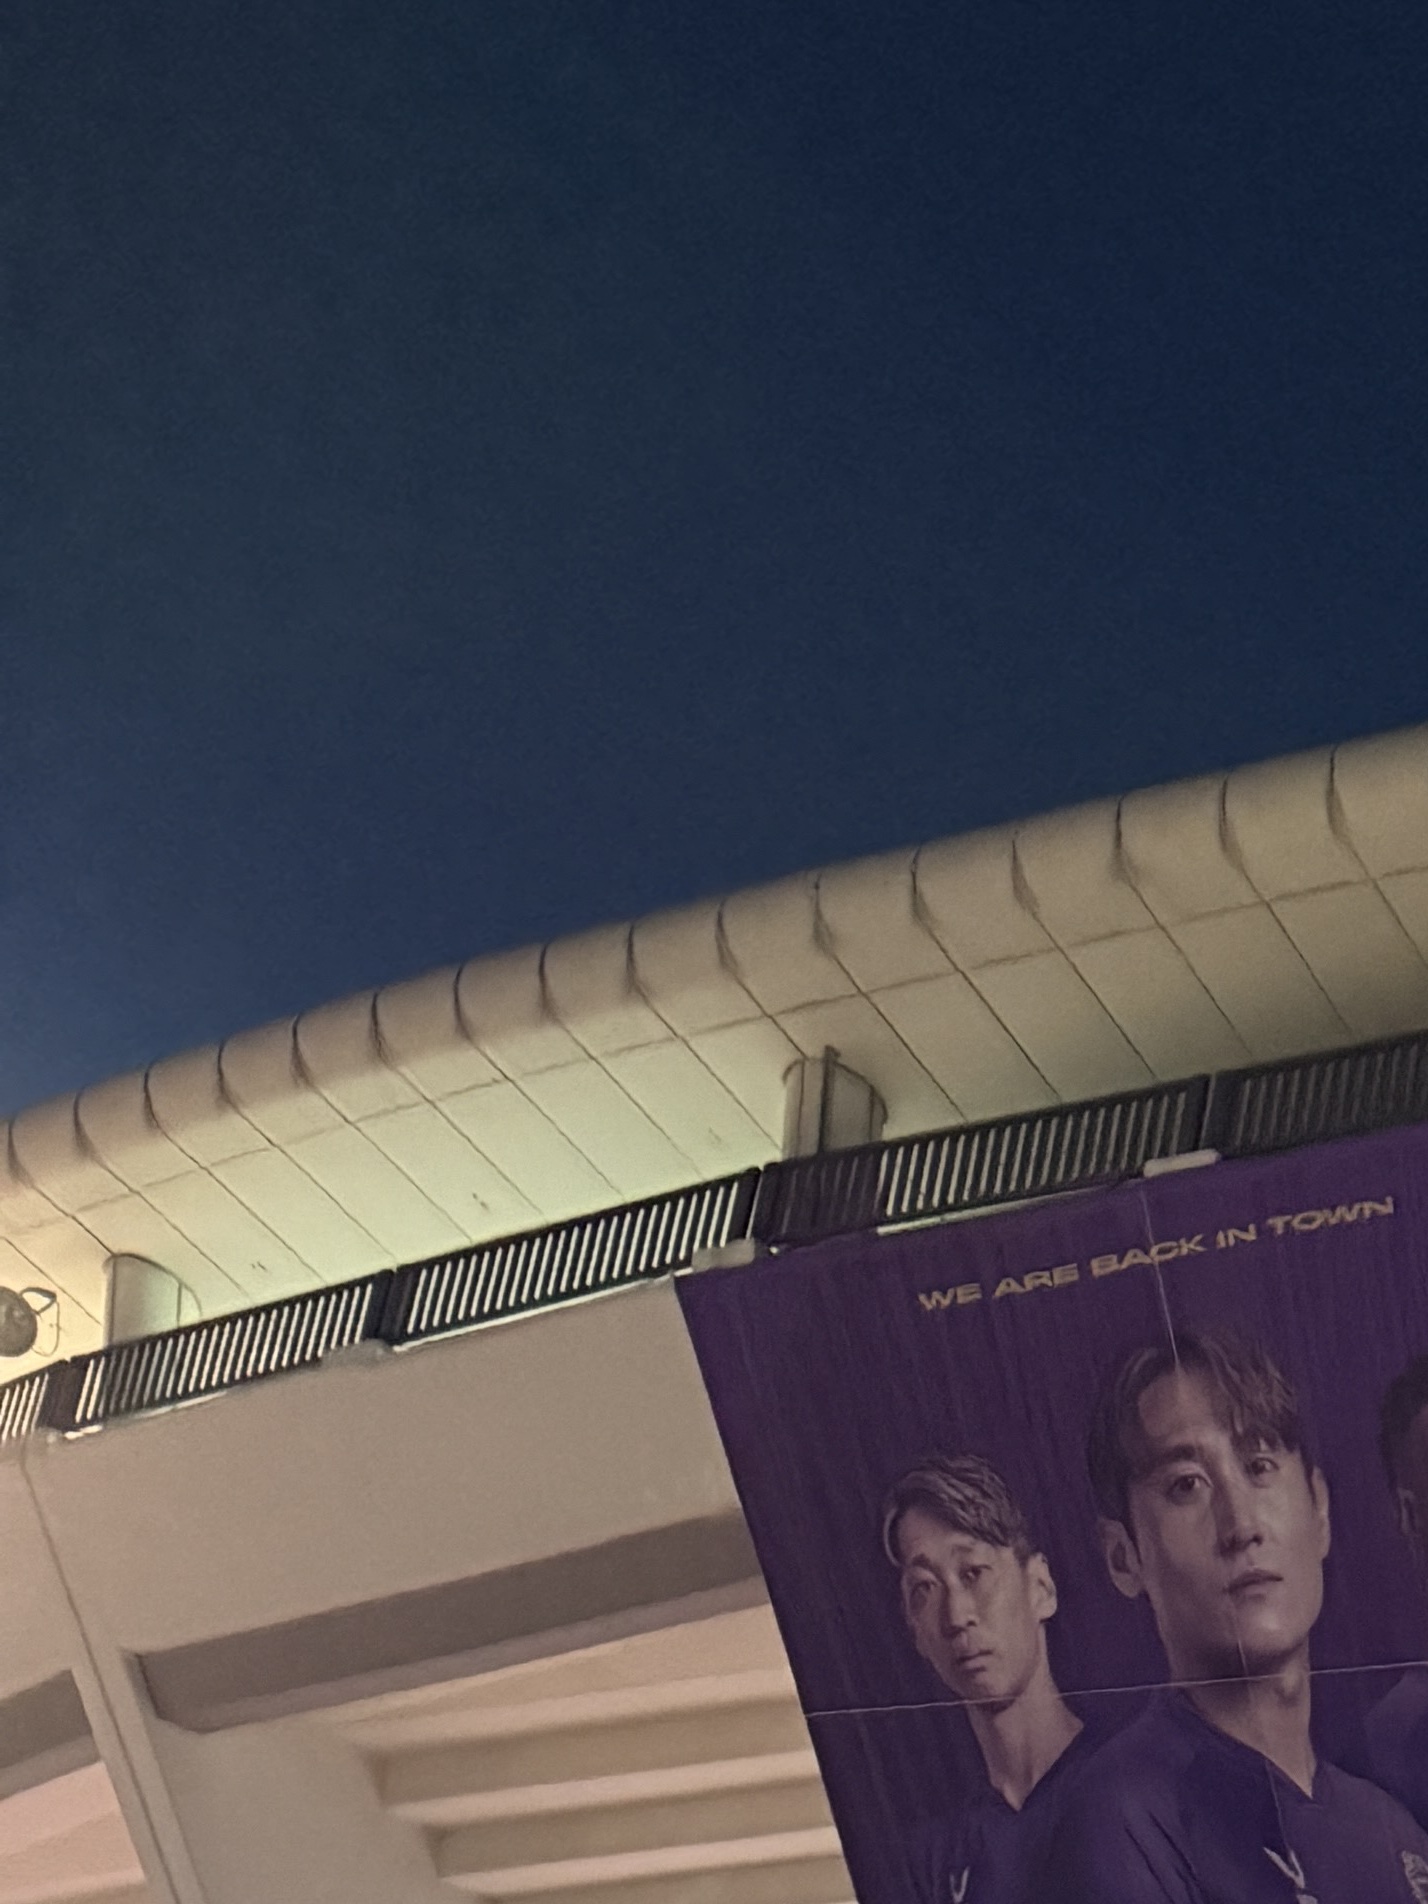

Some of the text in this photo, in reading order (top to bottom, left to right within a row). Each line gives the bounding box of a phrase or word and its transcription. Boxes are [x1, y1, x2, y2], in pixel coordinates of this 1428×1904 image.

[919, 1196, 1395, 1311] WE ARE BACK IN TOWN
